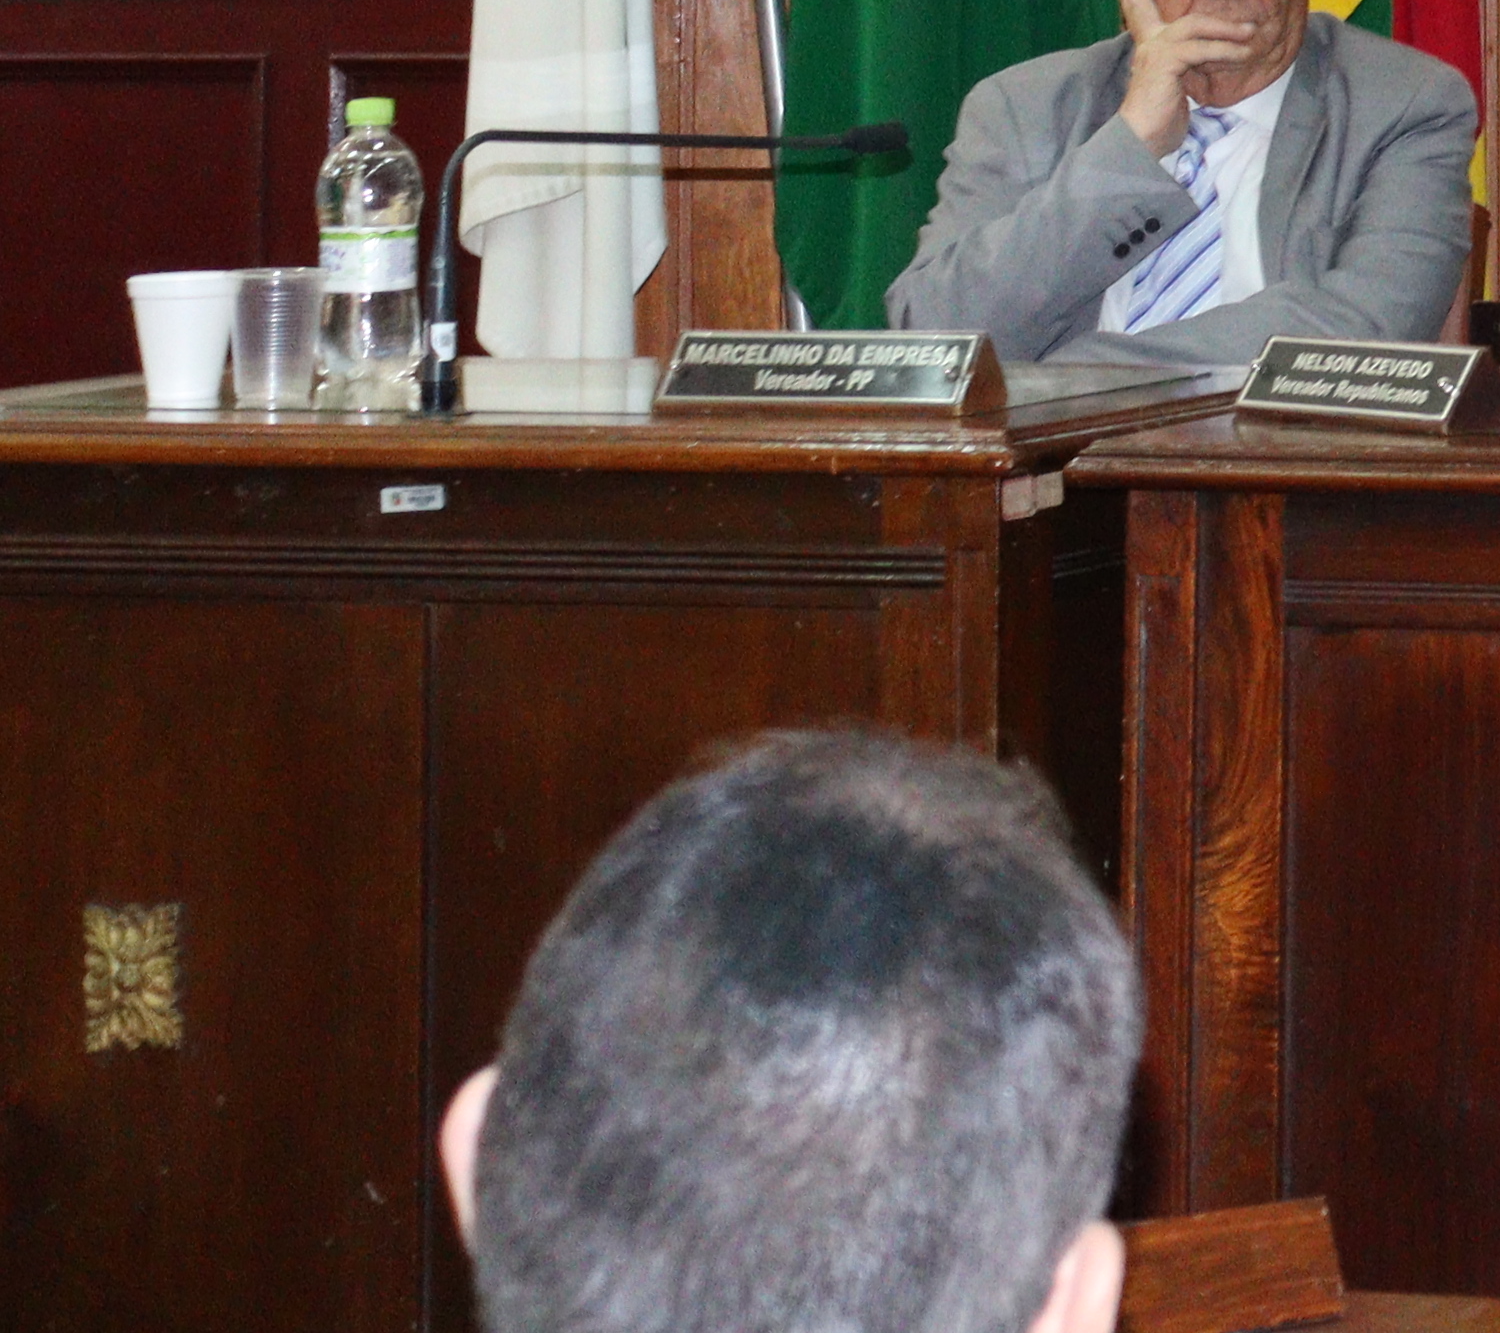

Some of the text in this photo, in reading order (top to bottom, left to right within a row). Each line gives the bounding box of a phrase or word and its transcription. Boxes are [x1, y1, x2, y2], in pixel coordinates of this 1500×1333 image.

[684, 343, 961, 366] MARCELINHO DA EMPRESA
[1291, 352, 1434, 380] NELSON AZEVEDO
[754, 369, 839, 391] Vereador
[846, 369, 876, 391] PP
[1270, 374, 1430, 405] Vereador Republicanos
